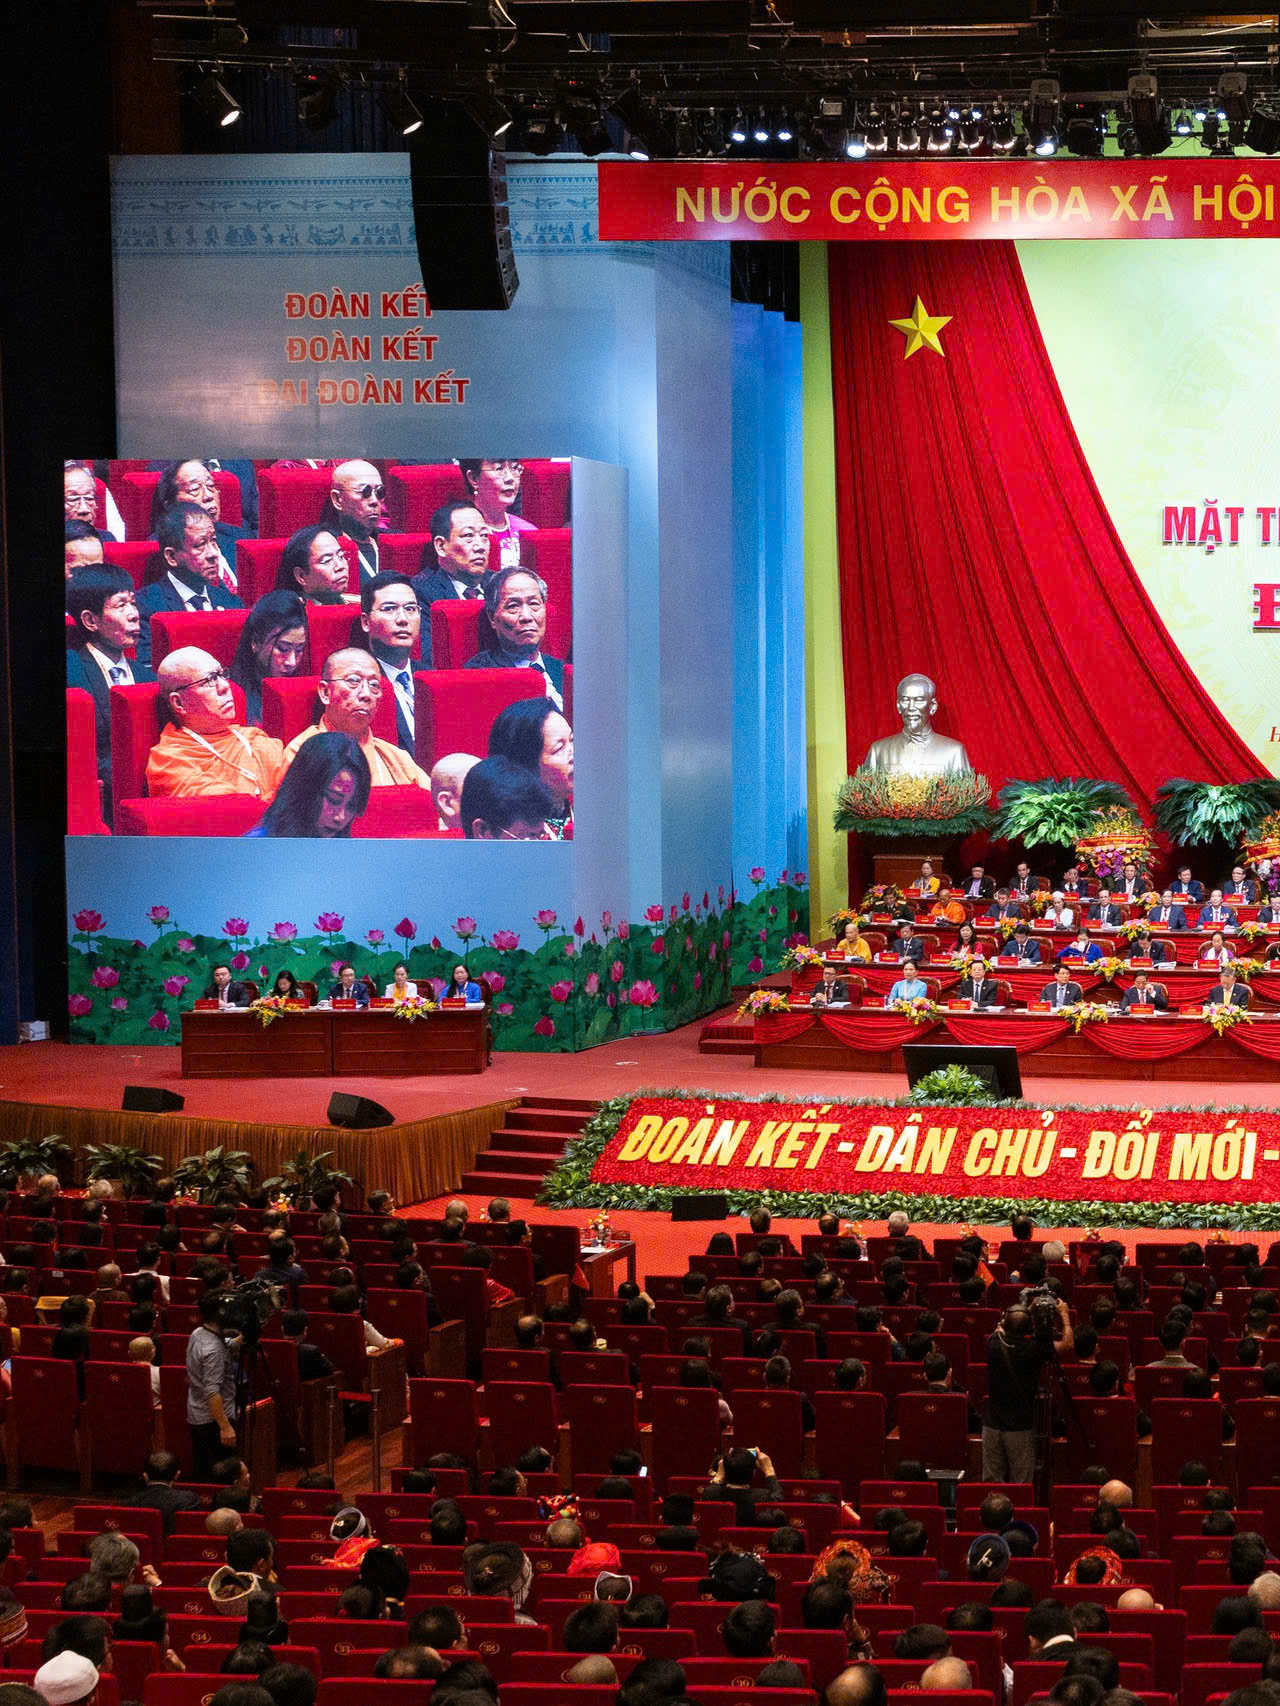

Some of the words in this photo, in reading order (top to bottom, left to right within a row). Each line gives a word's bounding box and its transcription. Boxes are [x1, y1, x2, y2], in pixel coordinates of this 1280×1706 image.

[676, 177, 810, 223] NƯỚC
[830, 177, 971, 231] CỘNG
[990, 175, 1092, 222] HÒA
[1110, 175, 1175, 221] XÃ
[1193, 173, 1274, 229] HỘI
[285, 287, 370, 319] ĐOÀN
[286, 331, 371, 363] ĐOÀN
[382, 327, 439, 362] KẾT
[317, 373, 403, 405] ĐOÀN
[413, 369, 470, 405] KẾT
[1163, 498, 1245, 552] MẶT
[616, 1104, 751, 1166] ĐOÀN
[745, 1104, 842, 1170] KẾT
[854, 1112, 959, 1175] DÂN
[962, 1110, 1059, 1178] CHỦ
[1081, 1109, 1162, 1181] ĐỔI
[1167, 1119, 1258, 1181] MỚI
